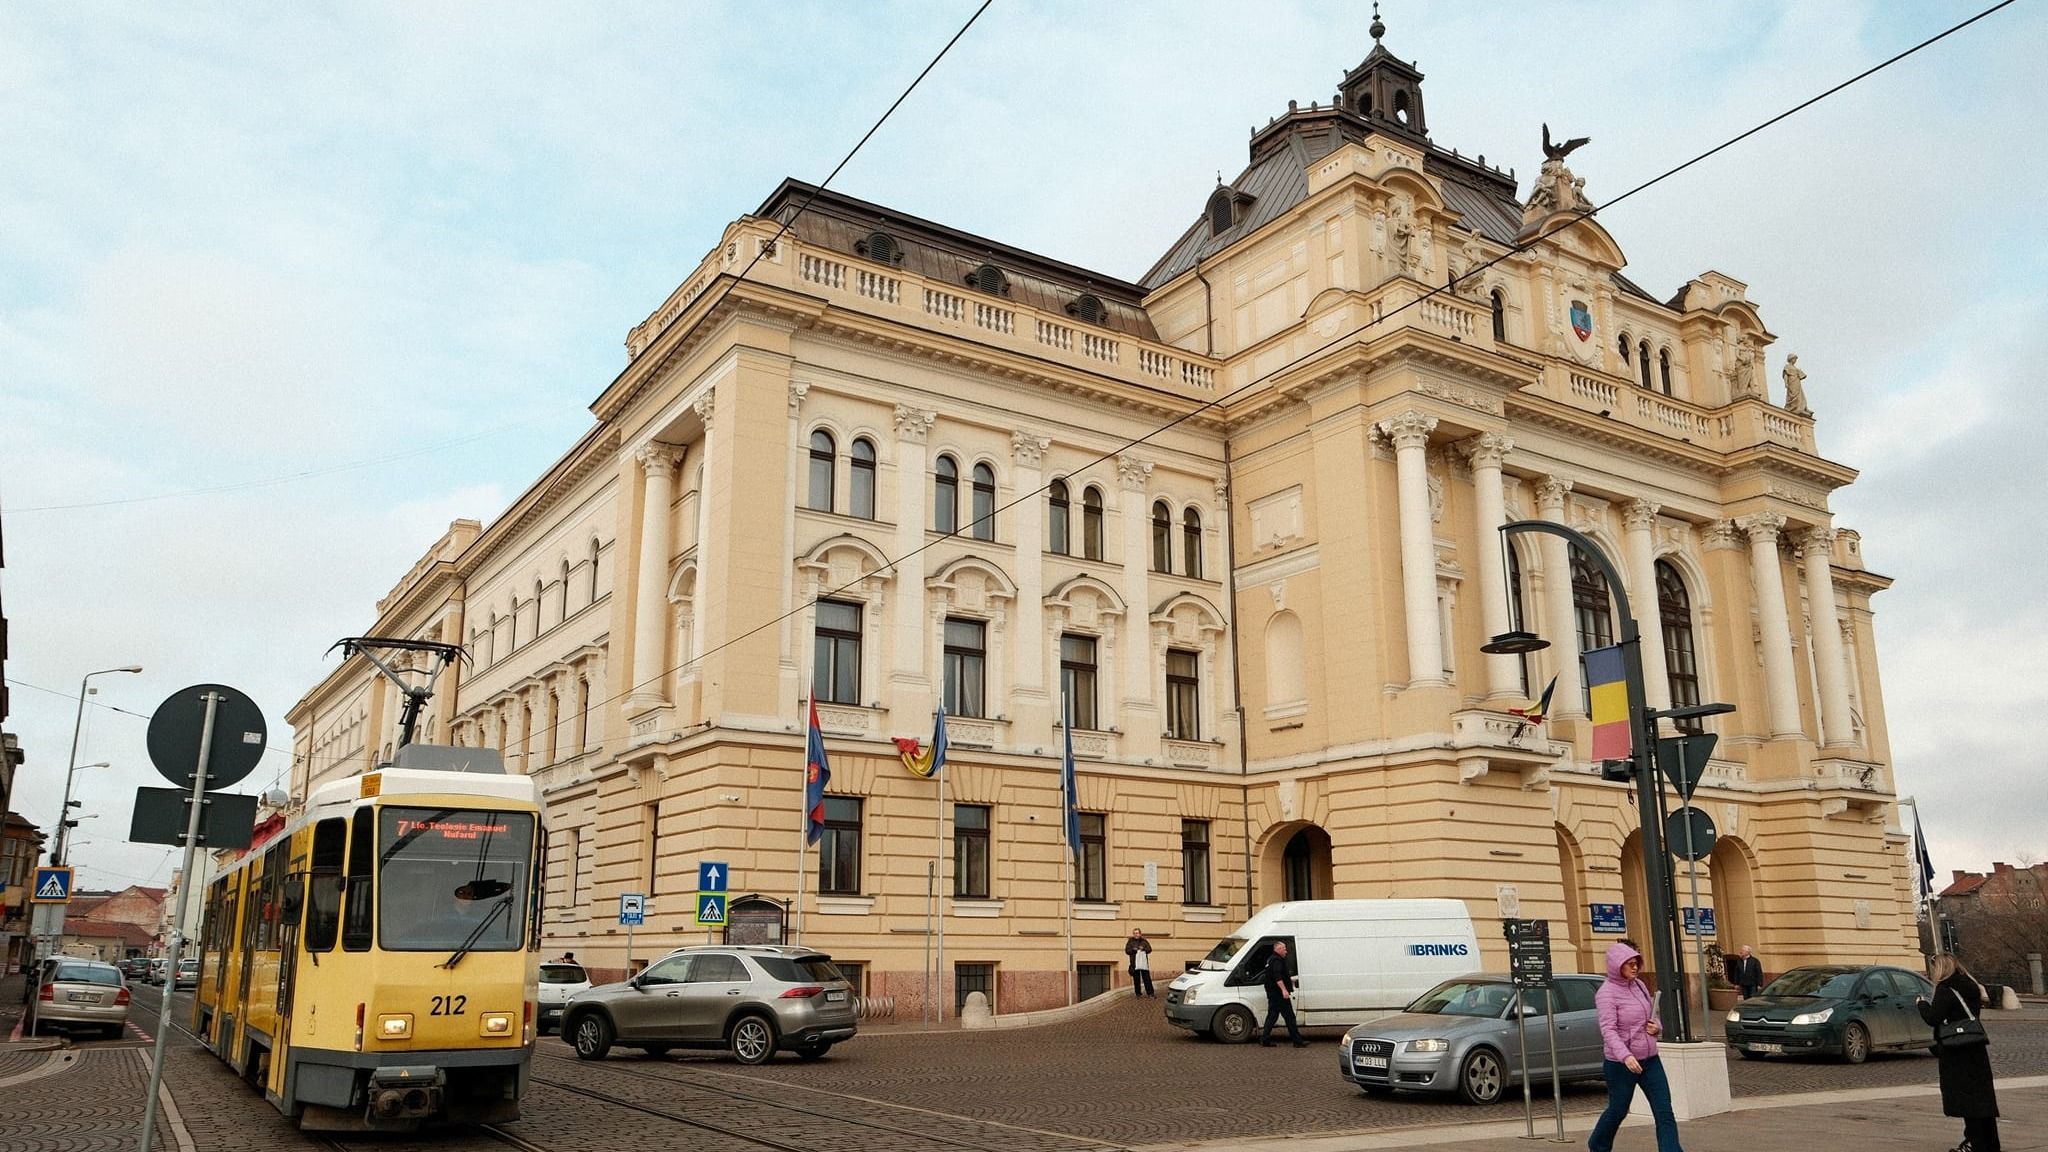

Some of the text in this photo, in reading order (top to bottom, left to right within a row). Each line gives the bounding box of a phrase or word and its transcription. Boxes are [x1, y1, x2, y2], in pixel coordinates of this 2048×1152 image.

[397, 820, 409, 837] 7
[469, 823, 507, 833] Emanuel
[1412, 943, 1469, 956] BRINKS
[430, 994, 467, 1016] 212
